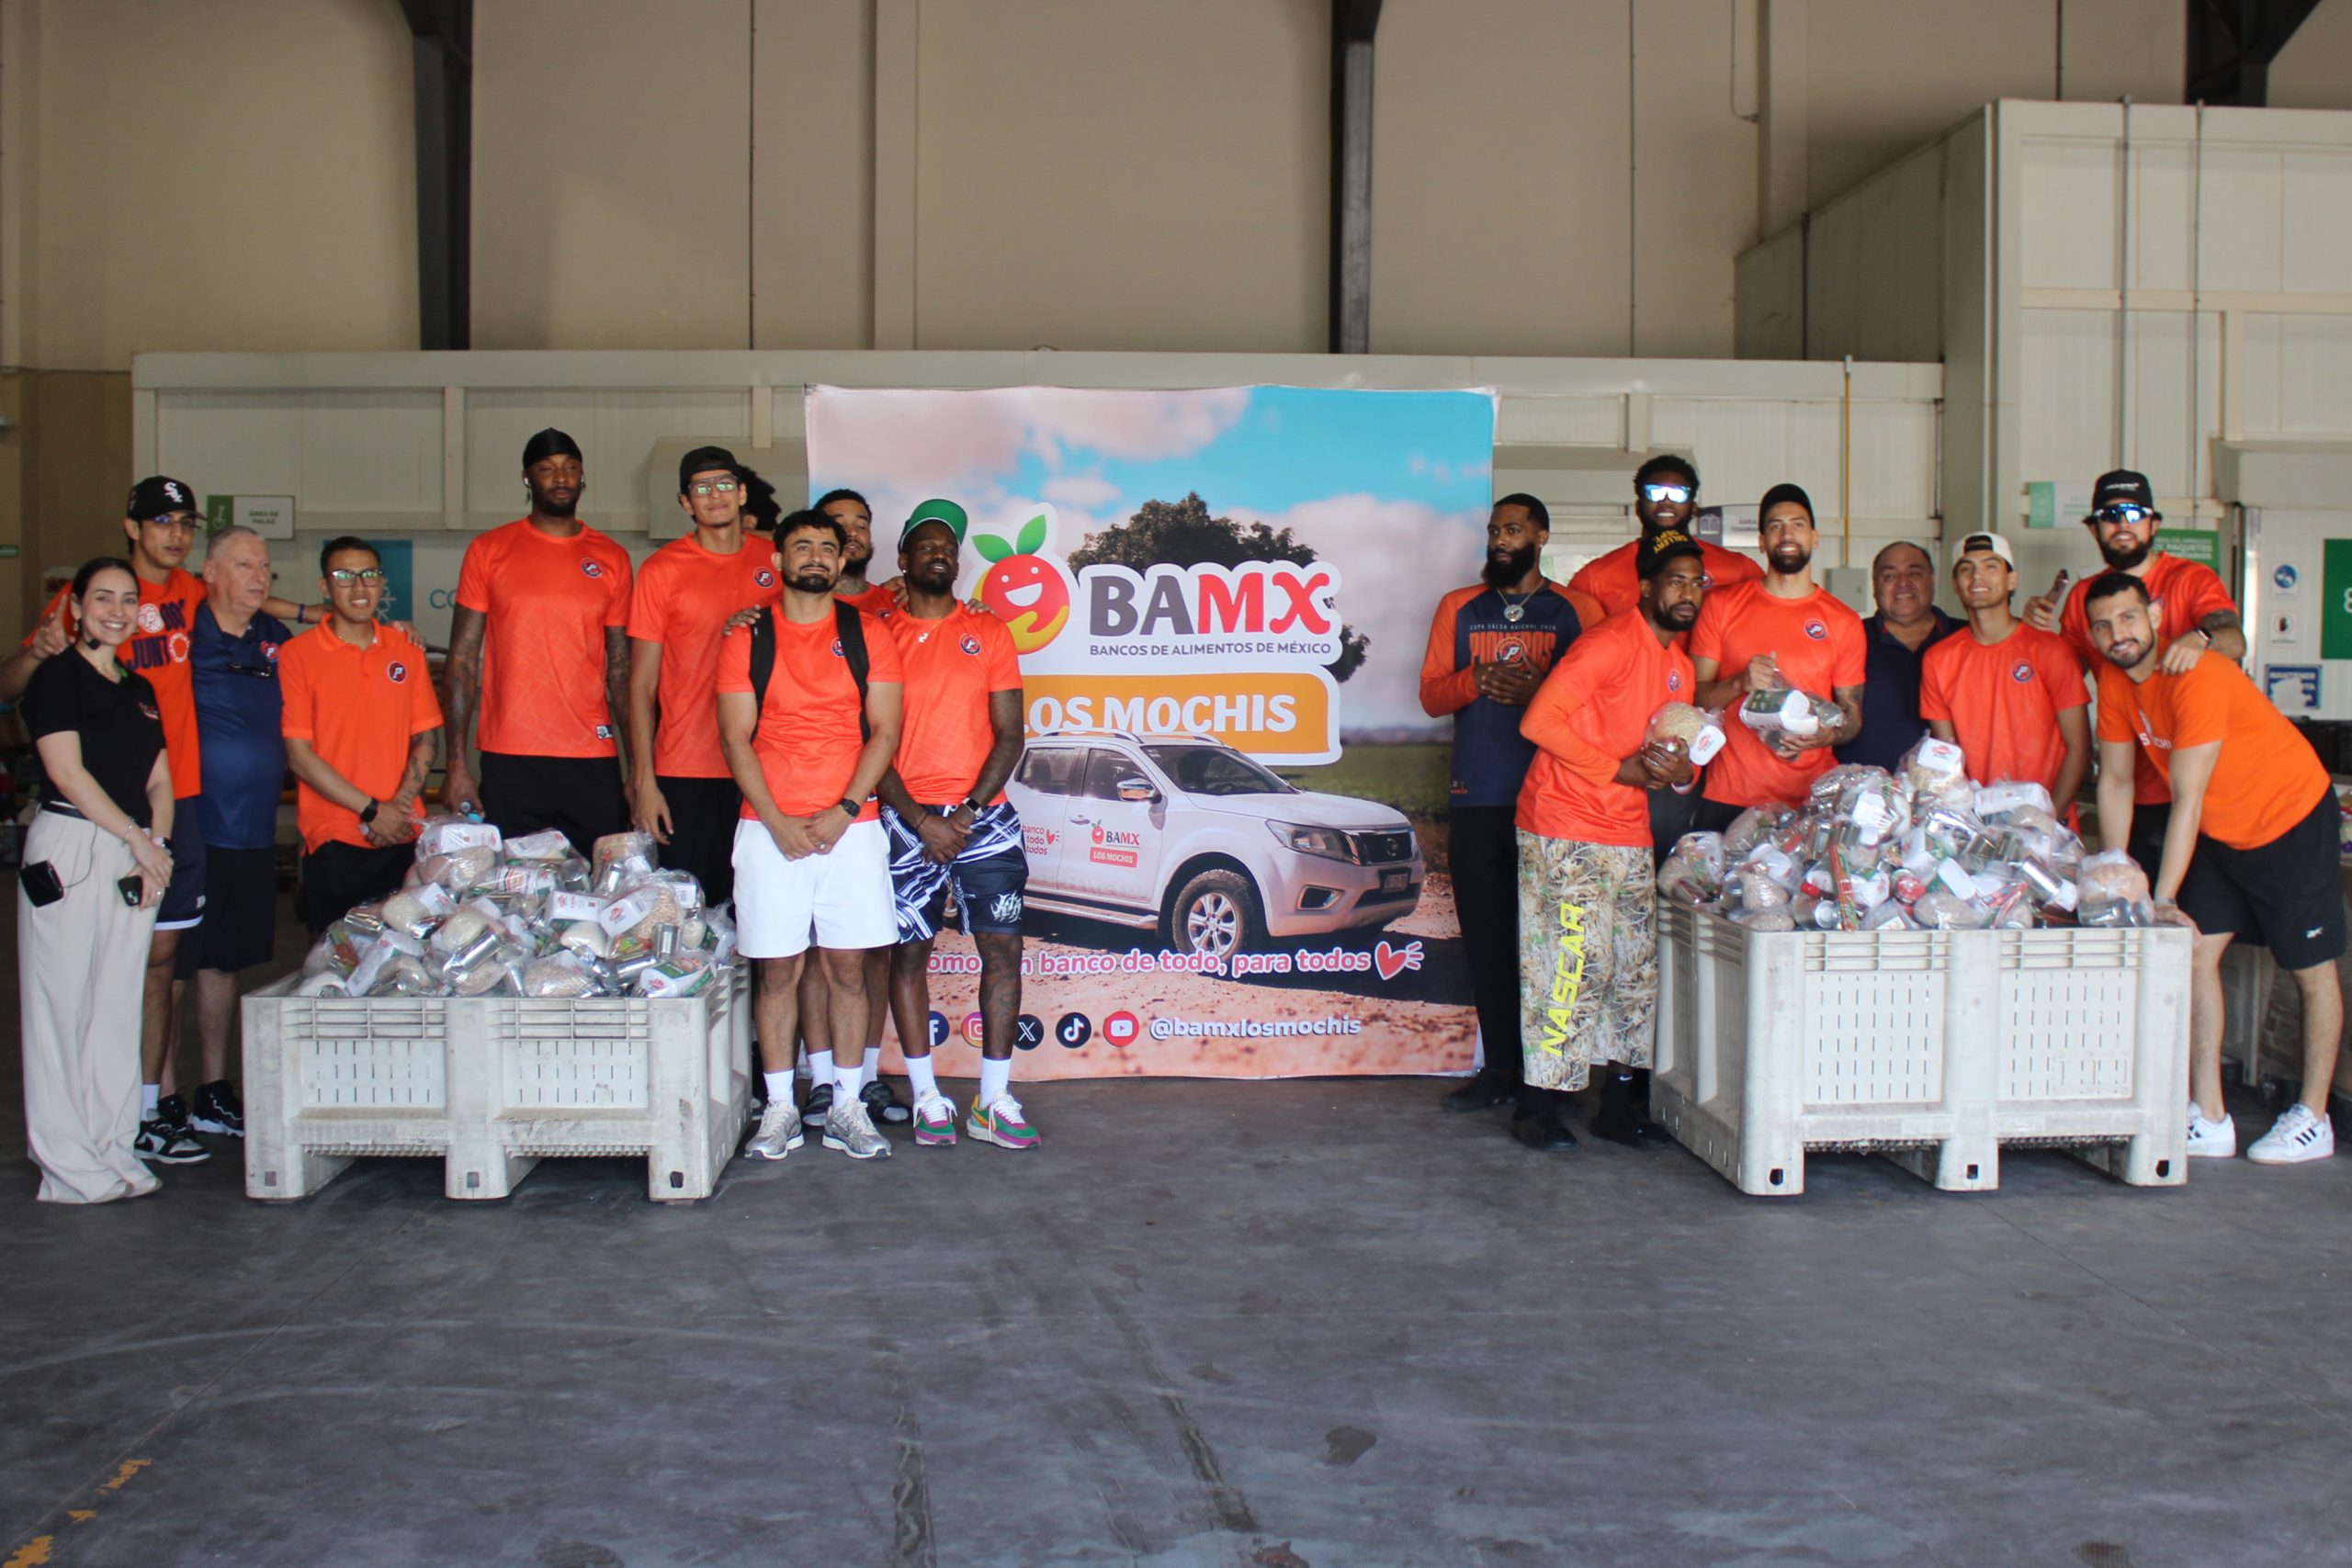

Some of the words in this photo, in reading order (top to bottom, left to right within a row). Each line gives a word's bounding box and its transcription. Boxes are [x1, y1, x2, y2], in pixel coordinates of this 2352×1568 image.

[1090, 571, 1331, 637] BAMX
[1090, 645, 1148, 656] BANCOS
[1151, 645, 1169, 655] DE
[1171, 642, 1252, 655] ALIMENTOS
[1256, 642, 1274, 653] DE
[1277, 640, 1331, 654] MÉXICO
[1024, 696, 1093, 734] OS
[1103, 694, 1296, 734] MOCHIS
[1026, 835, 1045, 845] todo
[1106, 830, 1140, 846] BAMX
[1093, 851, 1106, 860] LOS
[1106, 852, 1134, 863] MOCHIS
[926, 953, 983, 974] omo
[1039, 952, 1116, 974] banco
[1123, 949, 1155, 972] de
[1159, 949, 1227, 976] todo,
[1233, 952, 1291, 976] para
[1296, 947, 1371, 972] todos
[1540, 900, 1586, 1057] NASCAR
[1150, 1014, 1363, 1041] @bamxlosmochis
